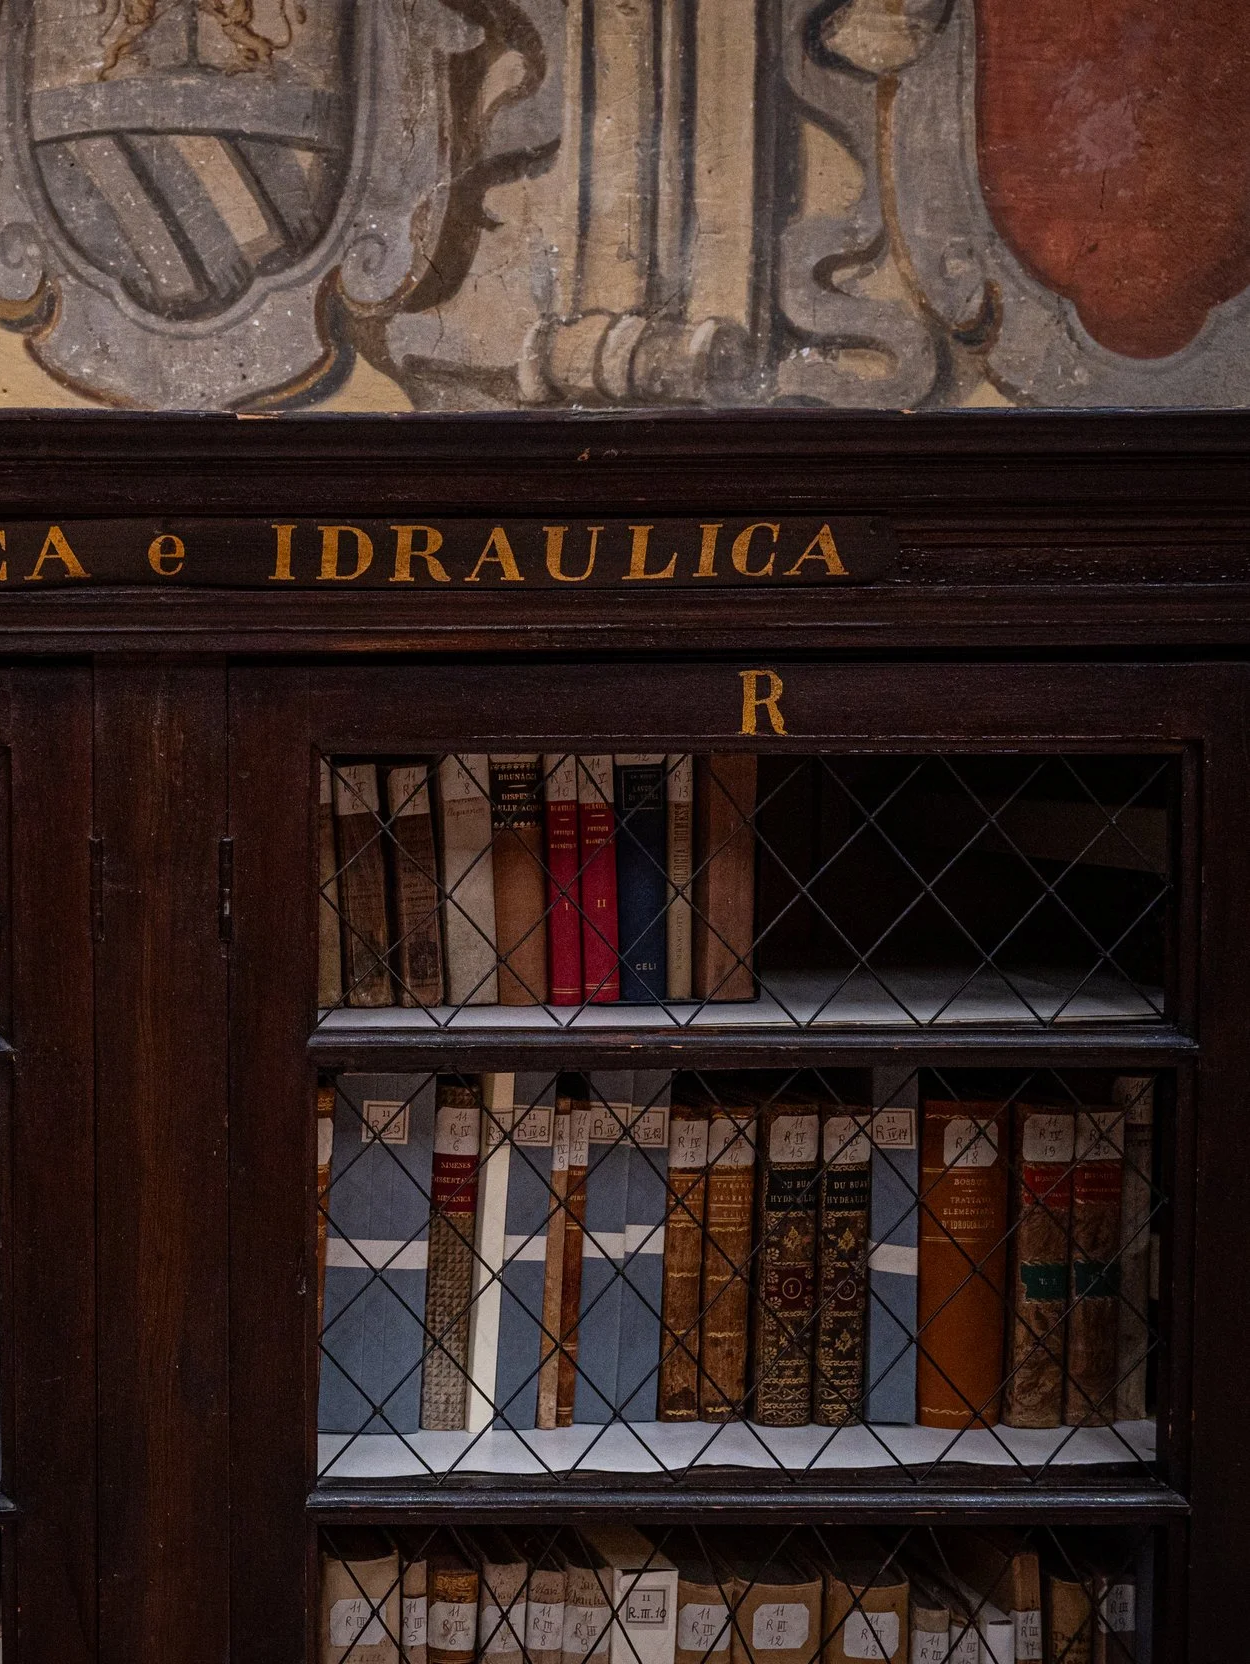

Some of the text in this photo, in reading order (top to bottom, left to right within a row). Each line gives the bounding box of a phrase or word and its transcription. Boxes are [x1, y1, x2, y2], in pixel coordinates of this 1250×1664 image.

[148, 536, 186, 575] e
[268, 523, 850, 582] IDRAULICA
[737, 669, 788, 736] R
[382, 1110, 391, 1118] 11
[455, 1110, 468, 1121] 11
[642, 1115, 650, 1123] 11
[593, 1118, 604, 1136] R
[682, 1123, 695, 1135] 11
[790, 1117, 804, 1130] 11
[450, 1123, 471, 1137] R IV
[517, 1122, 527, 1138] R
[538, 1125, 546, 1137] 8
[558, 1130, 564, 1140] R
[577, 1127, 584, 1139] R
[678, 1136, 701, 1149] R IV
[784, 1131, 806, 1145] R IV
[955, 1136, 963, 1149] R
[452, 1139, 460, 1152] 6
[573, 1153, 585, 1163] 10
[682, 1151, 696, 1163] 13
[789, 1147, 804, 1158] 15
[844, 1149, 858, 1161] 16
[963, 1150, 979, 1164] 18
[440, 1161, 472, 1169] XIMENES
[558, 1155, 565, 1169] 9
[833, 1181, 847, 1190] DU
[642, 1594, 650, 1602] 11
[350, 1601, 362, 1613] 11
[405, 1601, 417, 1613] 11
[448, 1606, 461, 1617] 11
[539, 1606, 551, 1618] 11
[772, 1605, 785, 1616] 11
[582, 1611, 593, 1622] 11
[697, 1607, 710, 1620] 11
[1023, 1612, 1034, 1625] 11
[402, 1617, 425, 1629] R III
[442, 1620, 468, 1632] R III
[533, 1617, 555, 1633] R III
[765, 1619, 789, 1632] R III
[575, 1622, 598, 1637] R III
[691, 1623, 716, 1637] R III
[1021, 1626, 1039, 1638] R III
[408, 1630, 418, 1642] 5
[449, 1633, 457, 1646] 6
[540, 1634, 546, 1646] 8
[767, 1635, 784, 1647] 12
[926, 1634, 940, 1646] 11
[580, 1639, 589, 1653] 9
[695, 1637, 709, 1648] 11
[863, 1644, 878, 1657] 13
[920, 1648, 927, 1659] R
